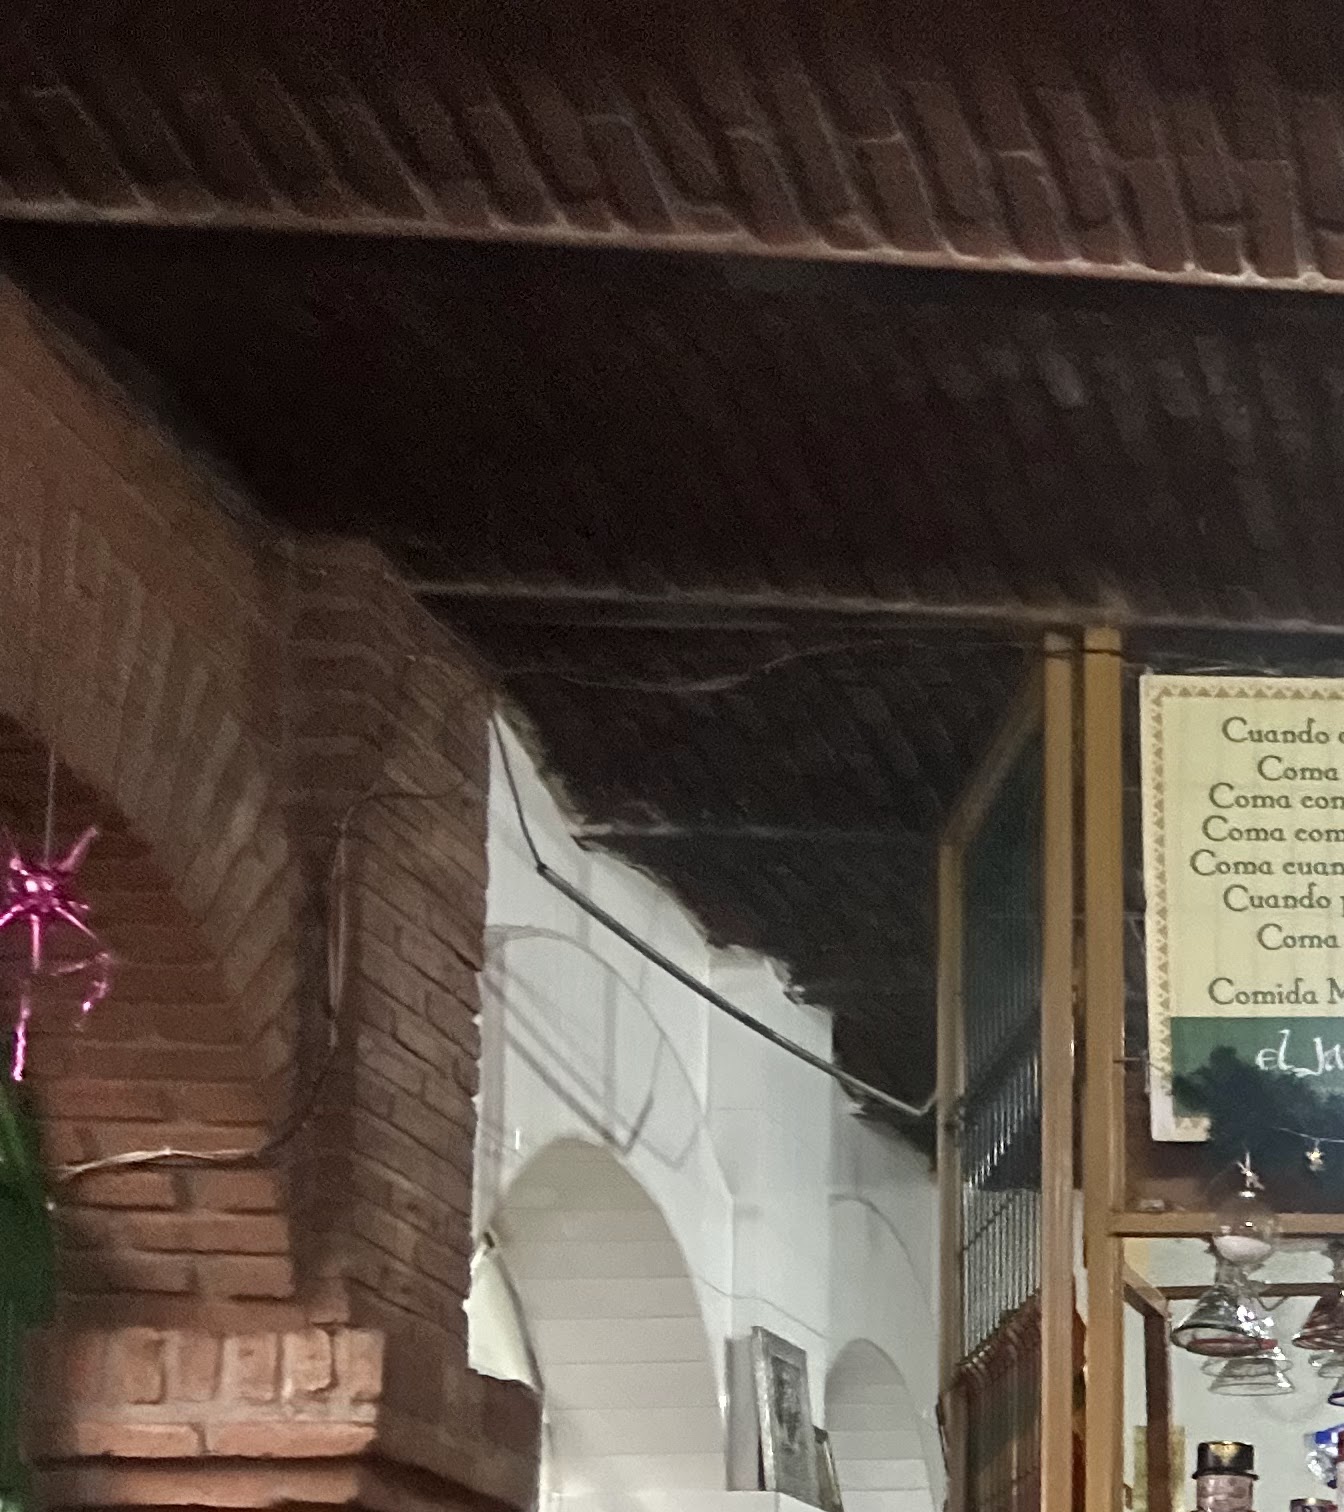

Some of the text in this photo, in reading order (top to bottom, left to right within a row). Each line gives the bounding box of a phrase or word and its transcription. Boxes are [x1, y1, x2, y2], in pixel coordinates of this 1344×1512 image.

[1221, 715, 1330, 745] Cuando
[1256, 754, 1340, 782] Coma
[1208, 781, 1293, 809] Coma
[1201, 814, 1287, 842] Coma
[1189, 848, 1275, 877] Coma
[1223, 882, 1332, 912] Cuando
[1256, 922, 1341, 951] Coma
[1207, 976, 1320, 1006] Comida
